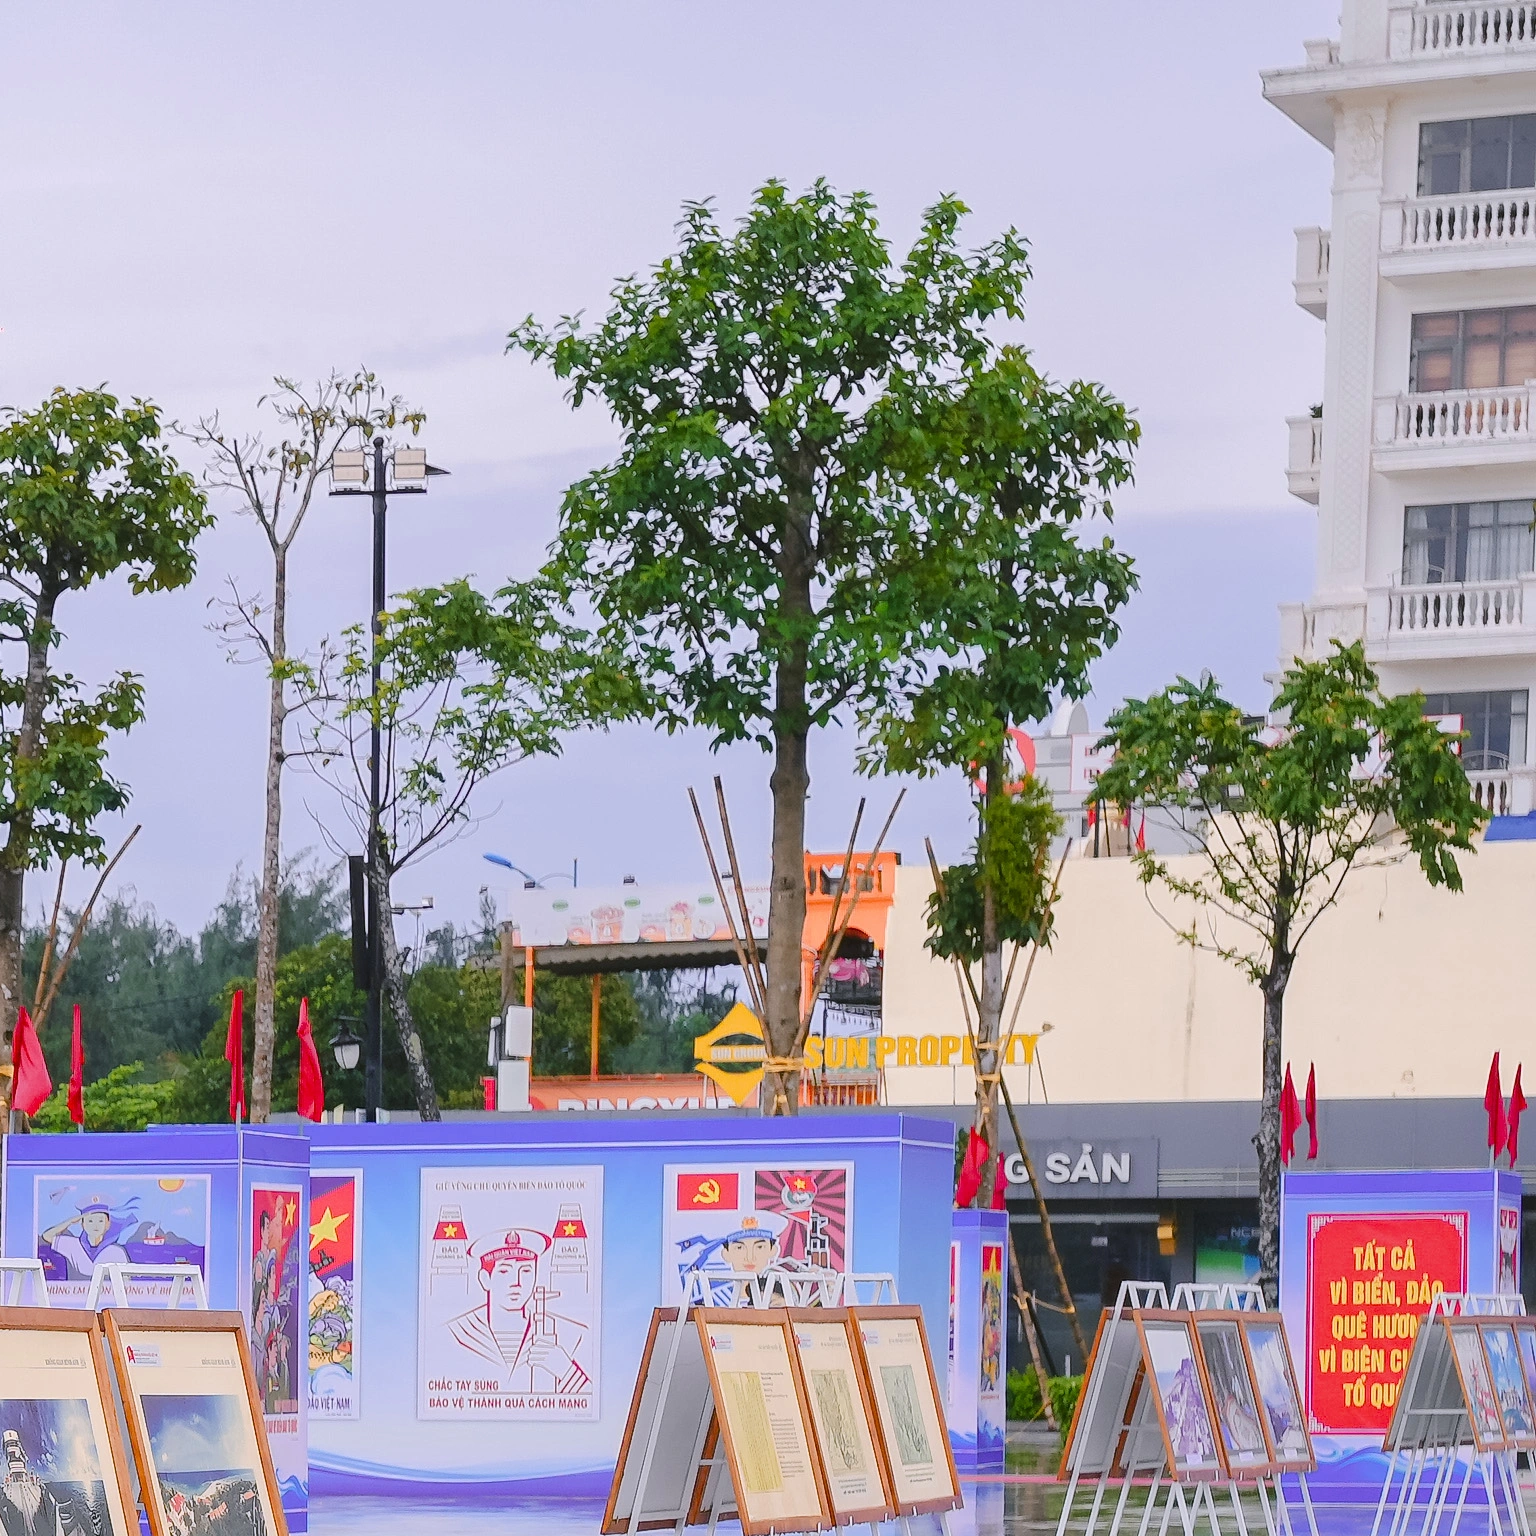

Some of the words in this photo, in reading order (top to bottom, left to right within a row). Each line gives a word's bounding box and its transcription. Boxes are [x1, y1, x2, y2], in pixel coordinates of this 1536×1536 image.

[712, 1046, 731, 1059] SUN
[804, 1036, 869, 1069] SUN
[876, 1034, 1039, 1067] PROPETY
[1045, 1143, 1131, 1183] SẢN
[1352, 1239, 1386, 1271] TẤT
[1391, 1239, 1416, 1271] CẢ
[1330, 1276, 1347, 1305] VÌ
[1352, 1272, 1401, 1307] BIỂN,
[1406, 1273, 1444, 1305] ĐẢO
[1332, 1310, 1367, 1341] QUÊ
[1372, 1313, 1418, 1339] HƯƠN
[1319, 1344, 1336, 1373] VÌ
[1341, 1344, 1384, 1373] BIÊN
[428, 1376, 452, 1391] CHẮC
[456, 1380, 471, 1391] TAY
[474, 1378, 498, 1391] SÚNG
[1343, 1374, 1366, 1407] TỔ
[429, 1395, 449, 1408] BẢO
[452, 1396, 464, 1410] VỆ
[468, 1396, 501, 1408] THÀNH
[528, 1396, 555, 1408] CÁCH
[558, 1398, 588, 1411] MẠNG
